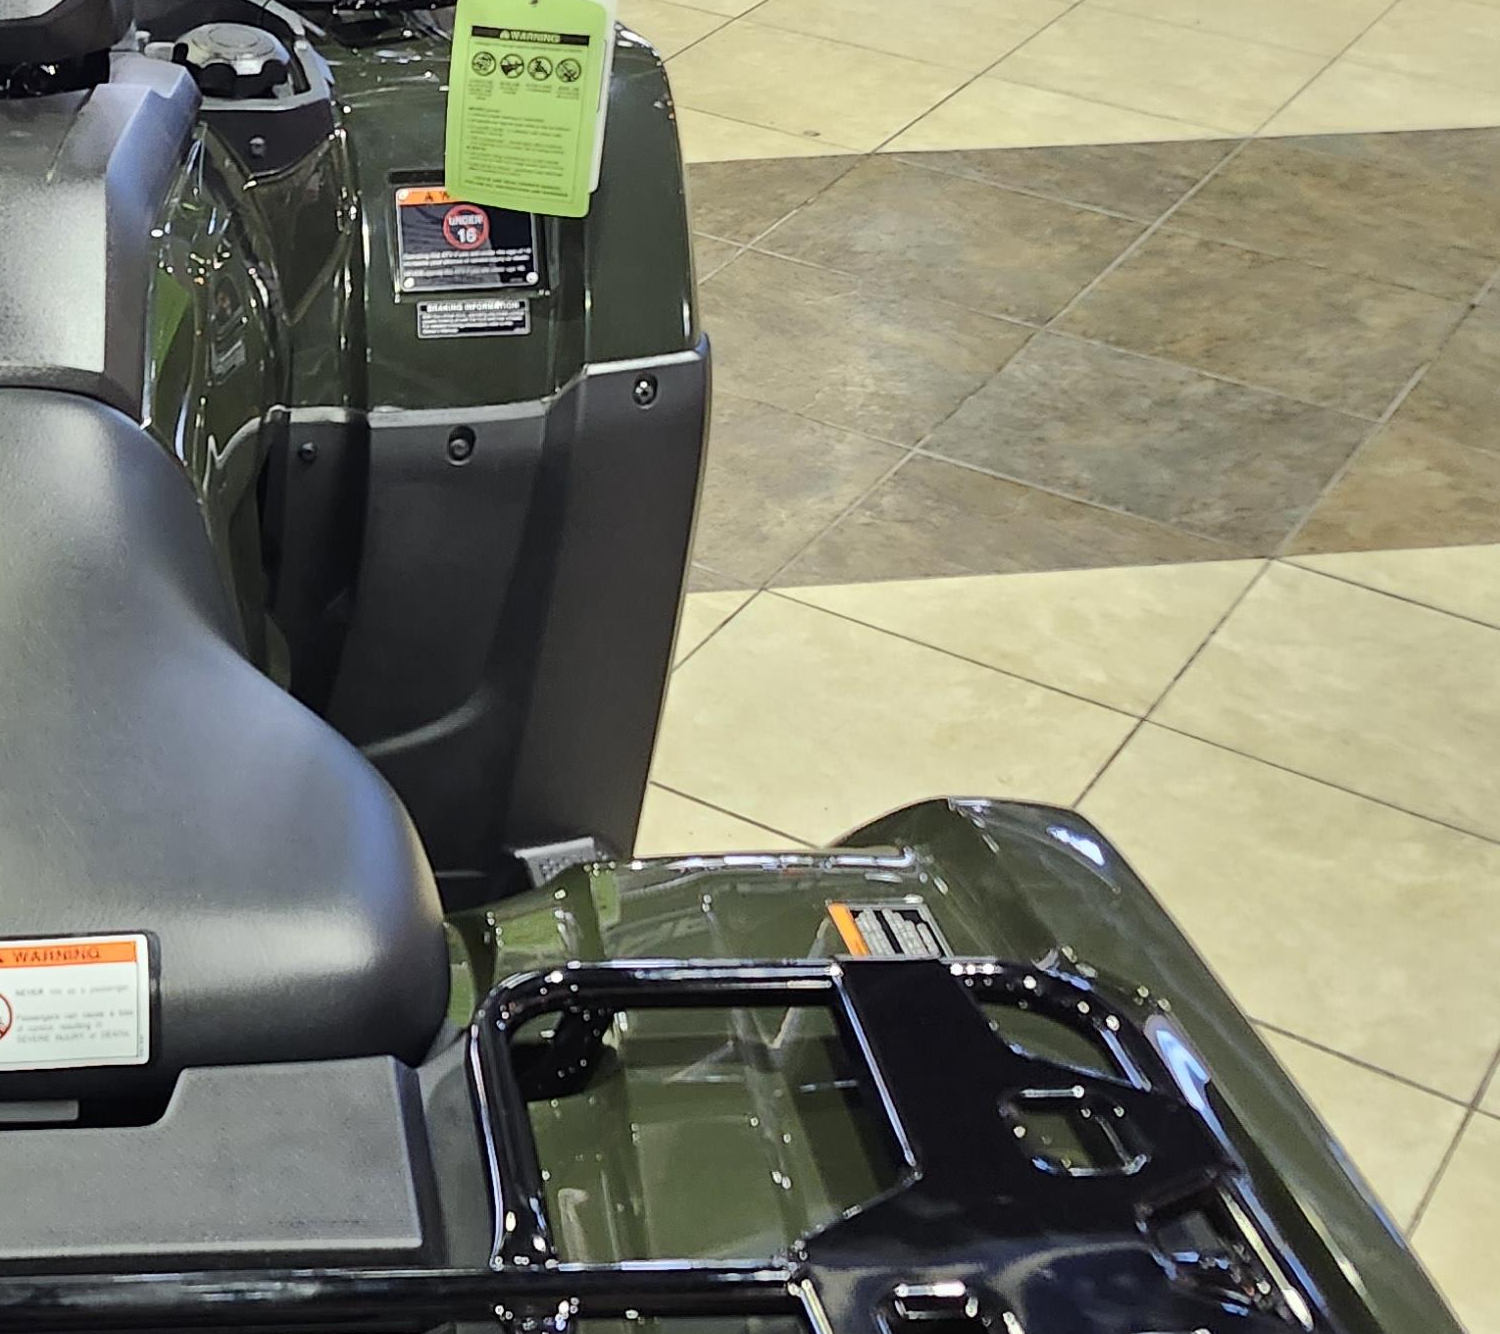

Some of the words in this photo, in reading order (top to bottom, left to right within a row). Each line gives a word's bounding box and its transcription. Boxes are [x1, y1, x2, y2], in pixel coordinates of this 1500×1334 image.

[511, 30, 561, 44] WARNING
[448, 214, 483, 227] UNDER
[457, 227, 478, 244] 16
[12, 948, 101, 964] WARNING
